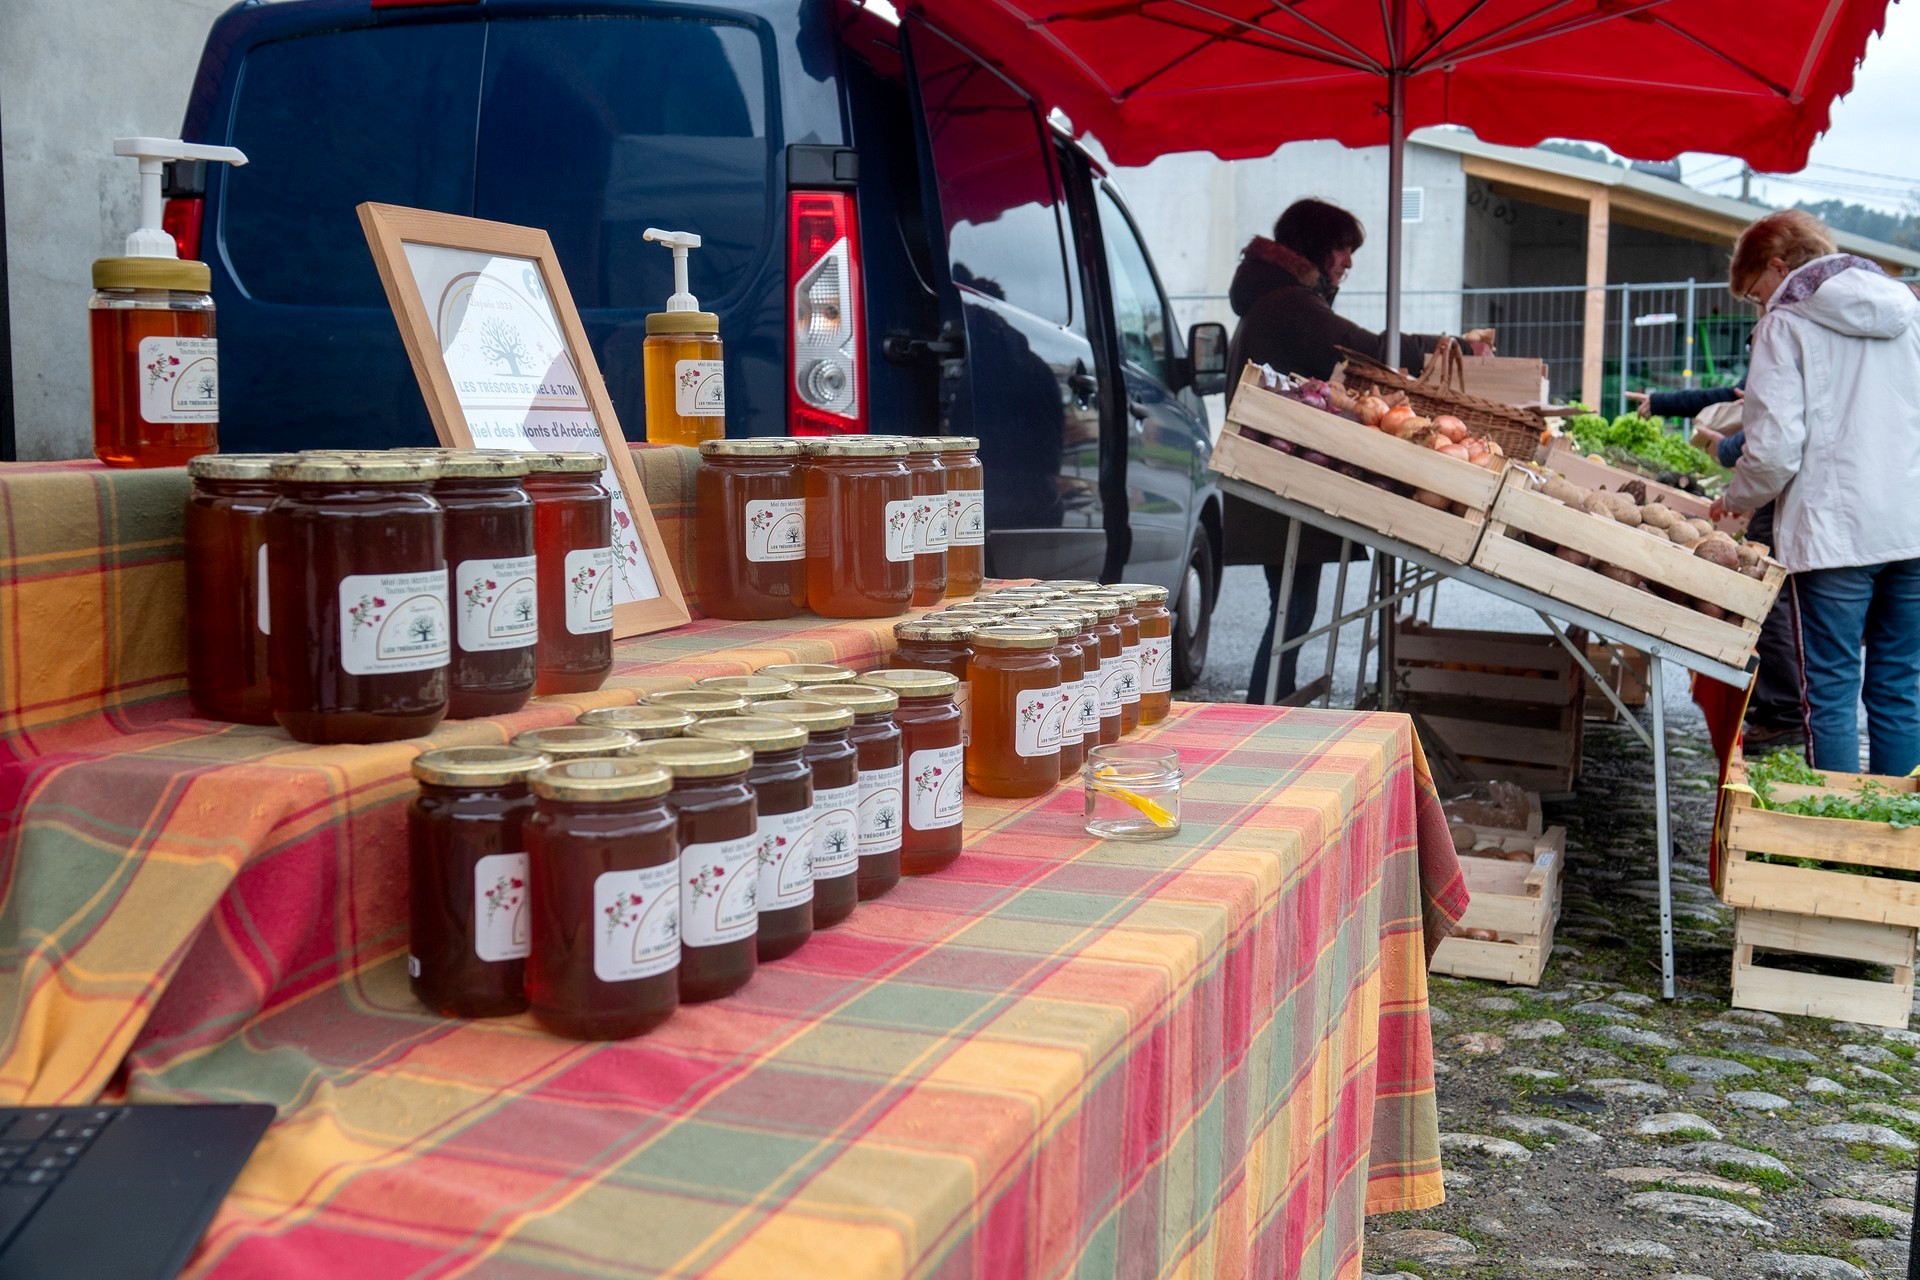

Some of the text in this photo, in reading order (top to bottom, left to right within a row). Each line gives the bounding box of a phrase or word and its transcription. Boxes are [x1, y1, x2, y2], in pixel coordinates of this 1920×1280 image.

[458, 380, 477, 393] LES
[477, 379, 519, 394] TRÉSORS
[519, 382, 532, 394] DE
[550, 384, 558, 395] &
[557, 384, 578, 396] TOM
[494, 421, 515, 438] des
[516, 423, 551, 438] Monts
[552, 421, 600, 438] d'Ardèche
[609, 487, 623, 500] ier
